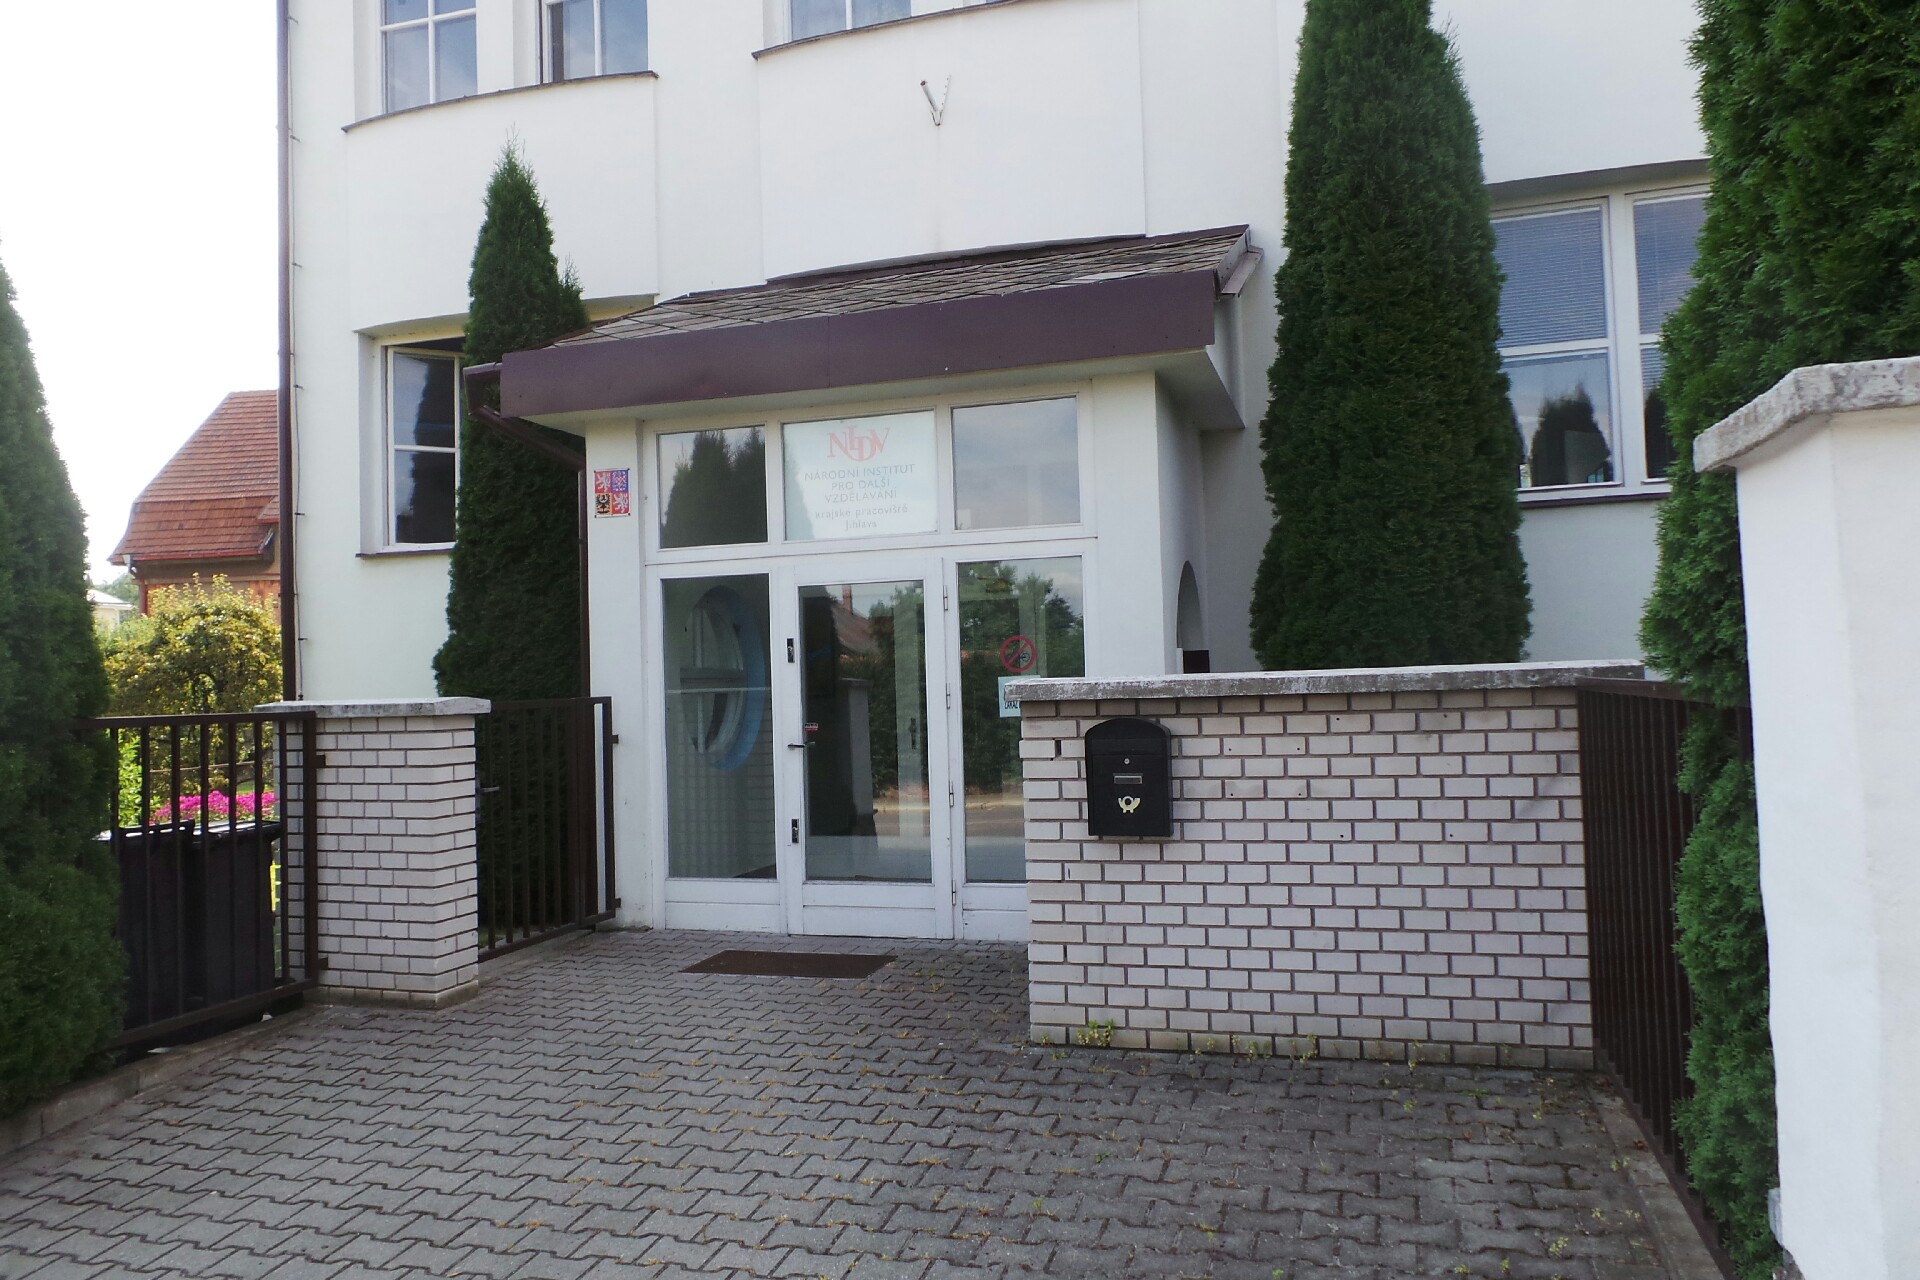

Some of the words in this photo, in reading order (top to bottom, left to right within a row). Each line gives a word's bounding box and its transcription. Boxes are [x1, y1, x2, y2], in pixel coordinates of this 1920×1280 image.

[804, 467, 859, 481] NÁRODNÍ
[863, 463, 916, 477] INSTITUT
[831, 481, 854, 491] PRO
[858, 477, 891, 489] DALŠÍ
